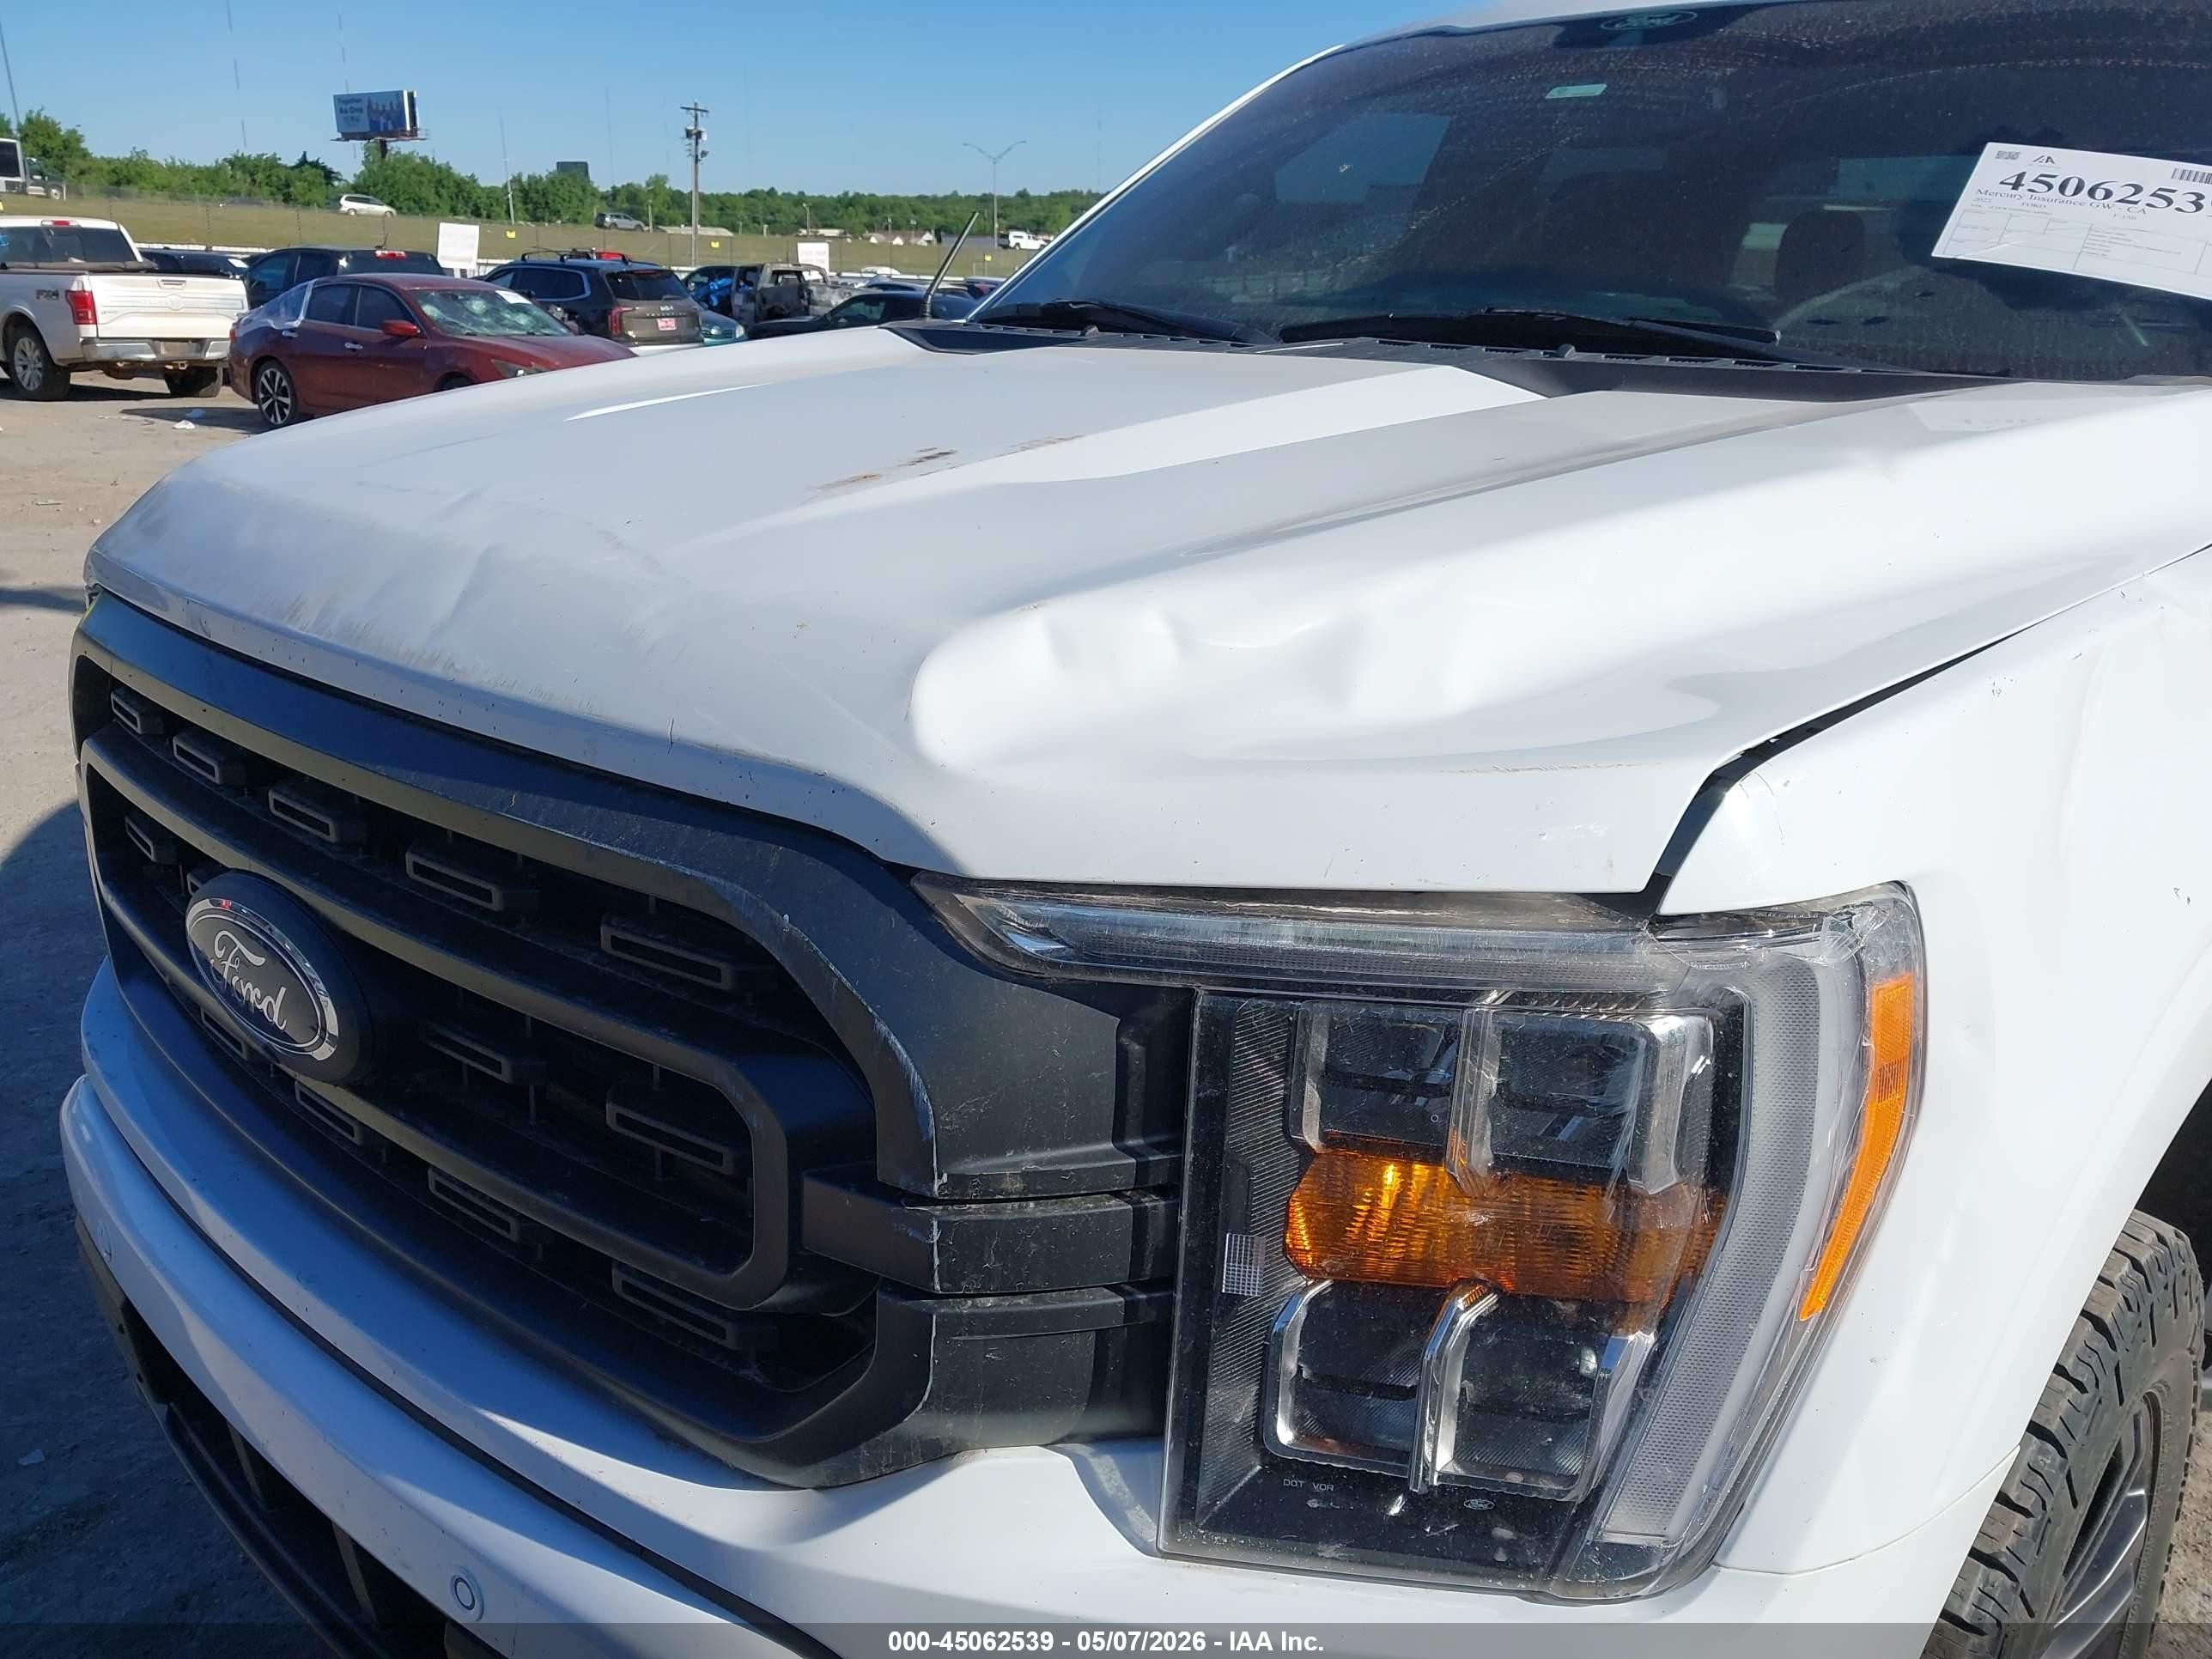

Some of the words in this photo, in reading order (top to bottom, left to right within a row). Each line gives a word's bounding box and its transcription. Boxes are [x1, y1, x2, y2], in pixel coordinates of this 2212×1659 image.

[1977, 188, 2025, 201] Mercury
[2029, 194, 2087, 206] Insurance
[2127, 206, 2147, 215] CA
[1999, 171, 2212, 214] 4506253
[209, 929, 287, 1031] Ford
[1283, 1478, 1304, 1488] DOT
[1312, 1481, 1334, 1492] VOR
